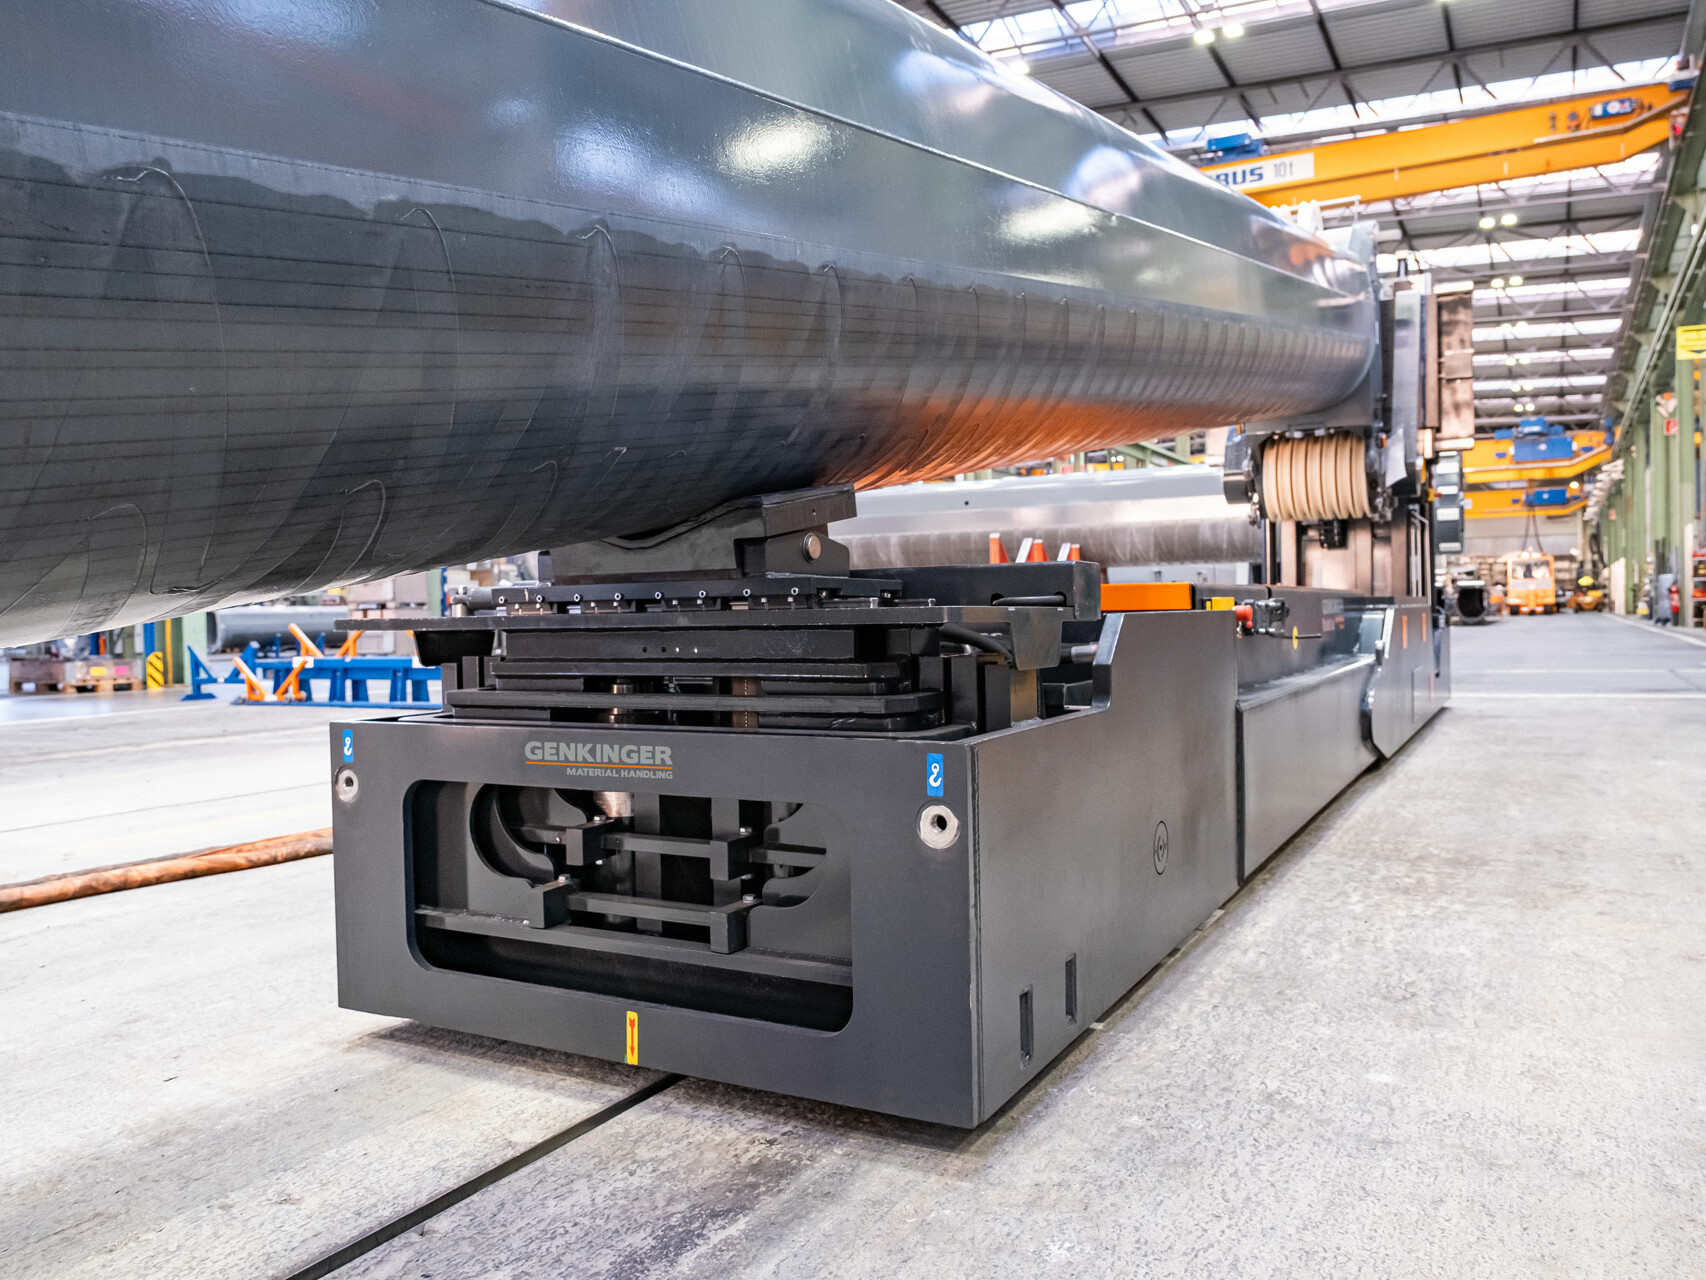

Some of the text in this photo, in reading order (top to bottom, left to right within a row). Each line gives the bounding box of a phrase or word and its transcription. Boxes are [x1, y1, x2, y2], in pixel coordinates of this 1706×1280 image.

[524, 741, 673, 765] GENKINGER
[566, 767, 673, 780] MATERIAL HANDLING
